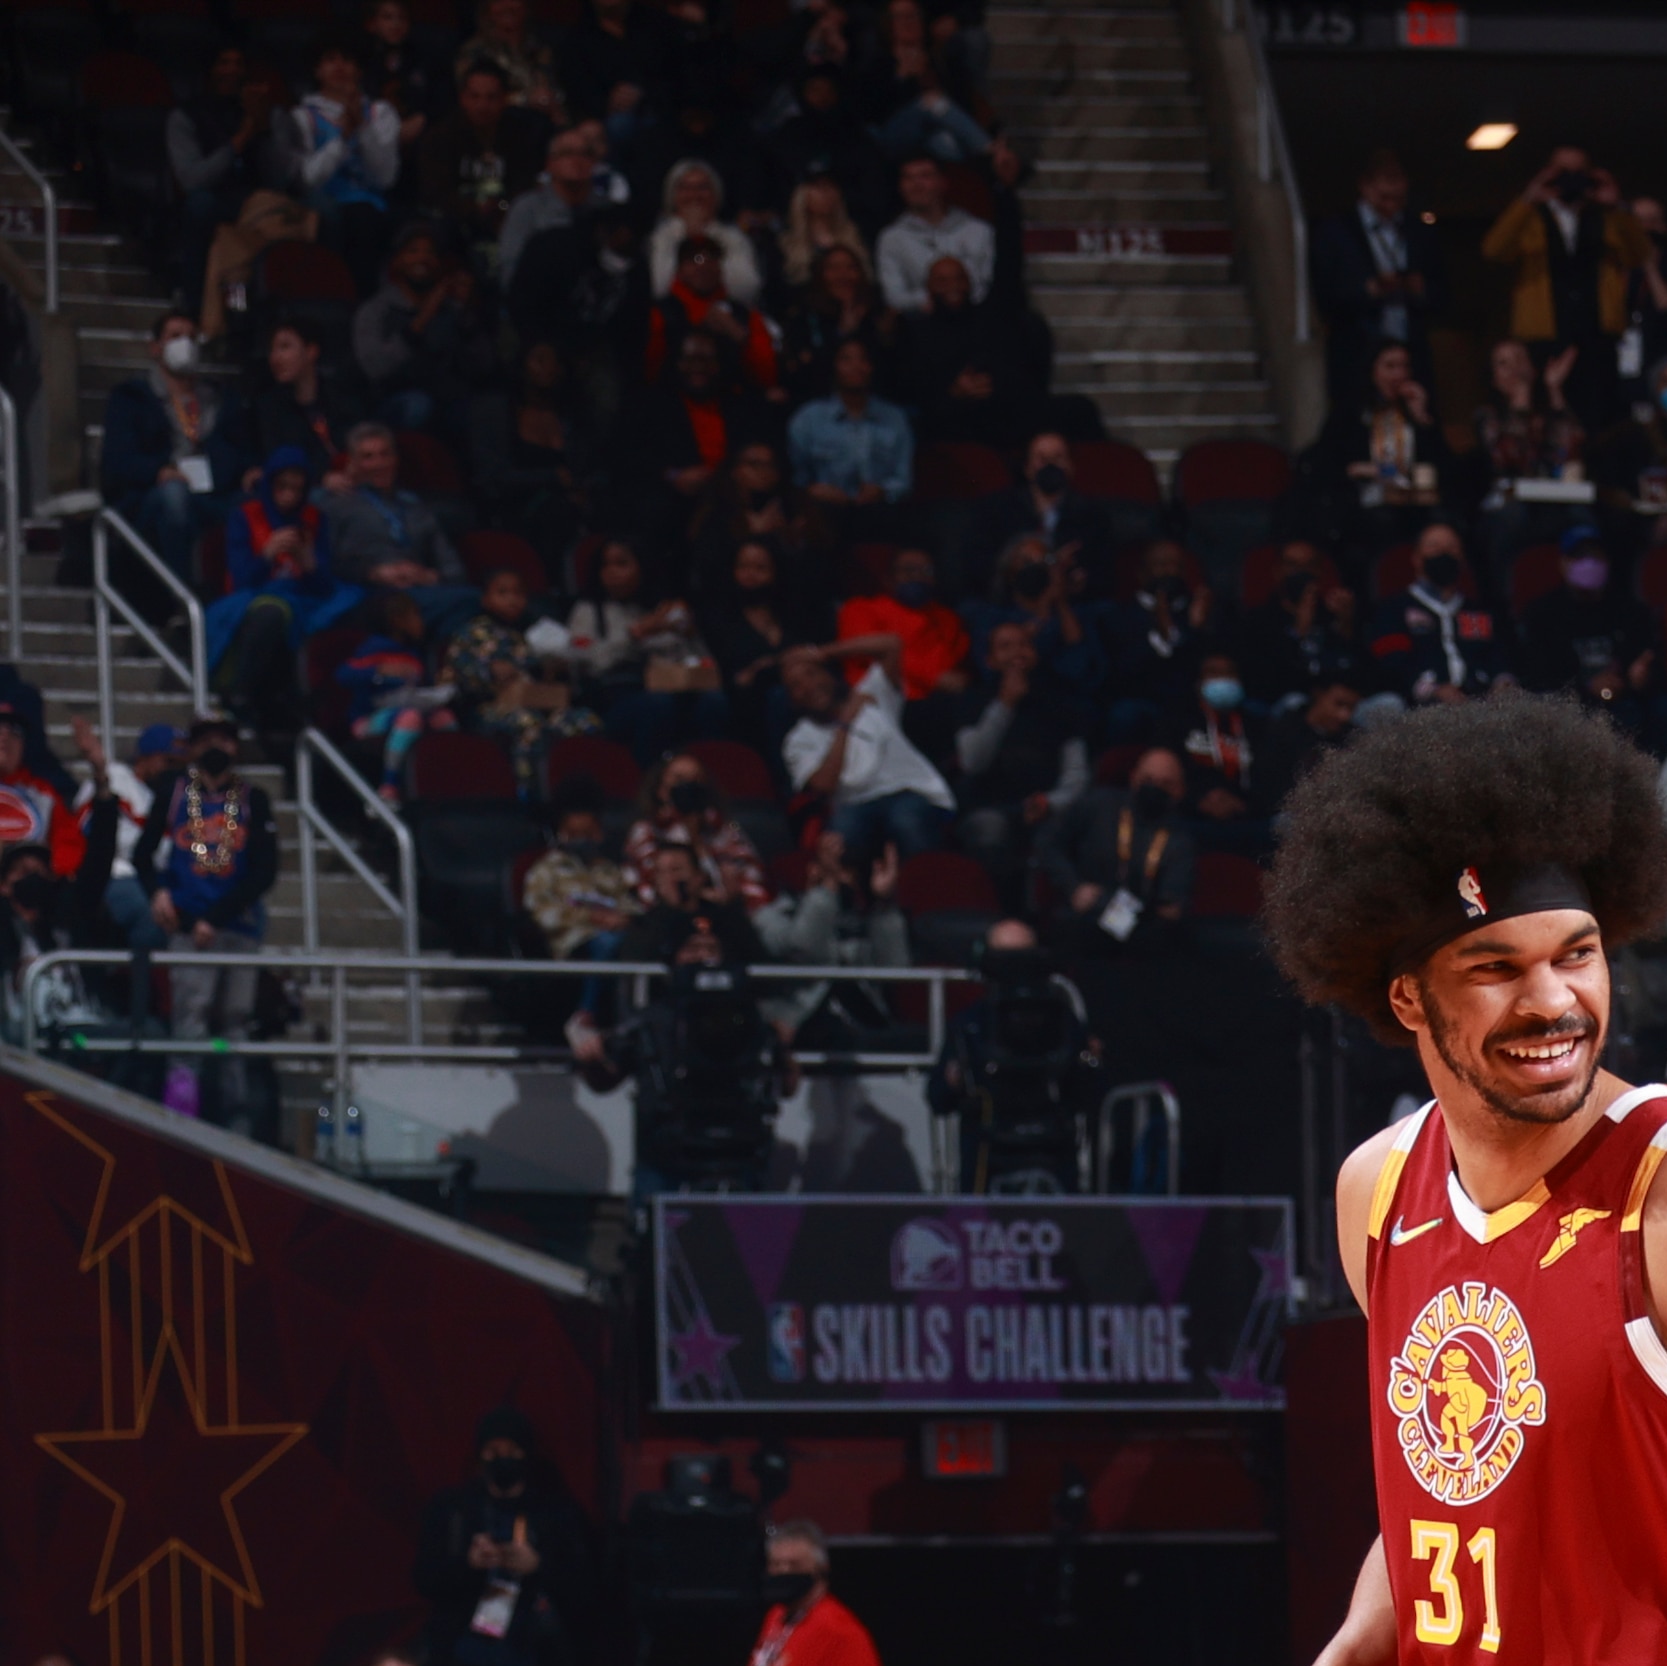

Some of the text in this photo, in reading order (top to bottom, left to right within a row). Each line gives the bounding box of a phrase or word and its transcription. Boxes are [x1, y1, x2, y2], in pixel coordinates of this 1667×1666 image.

[960, 1219, 1064, 1255] TACO
[968, 1256, 1066, 1291] BELL
[812, 1302, 1193, 1384] SKILLS CHALLENGE
[1388, 1282, 1546, 1425] CAVALIERS
[1398, 1417, 1525, 1505] CLEVELAND
[1410, 1519, 1501, 1654] 31
